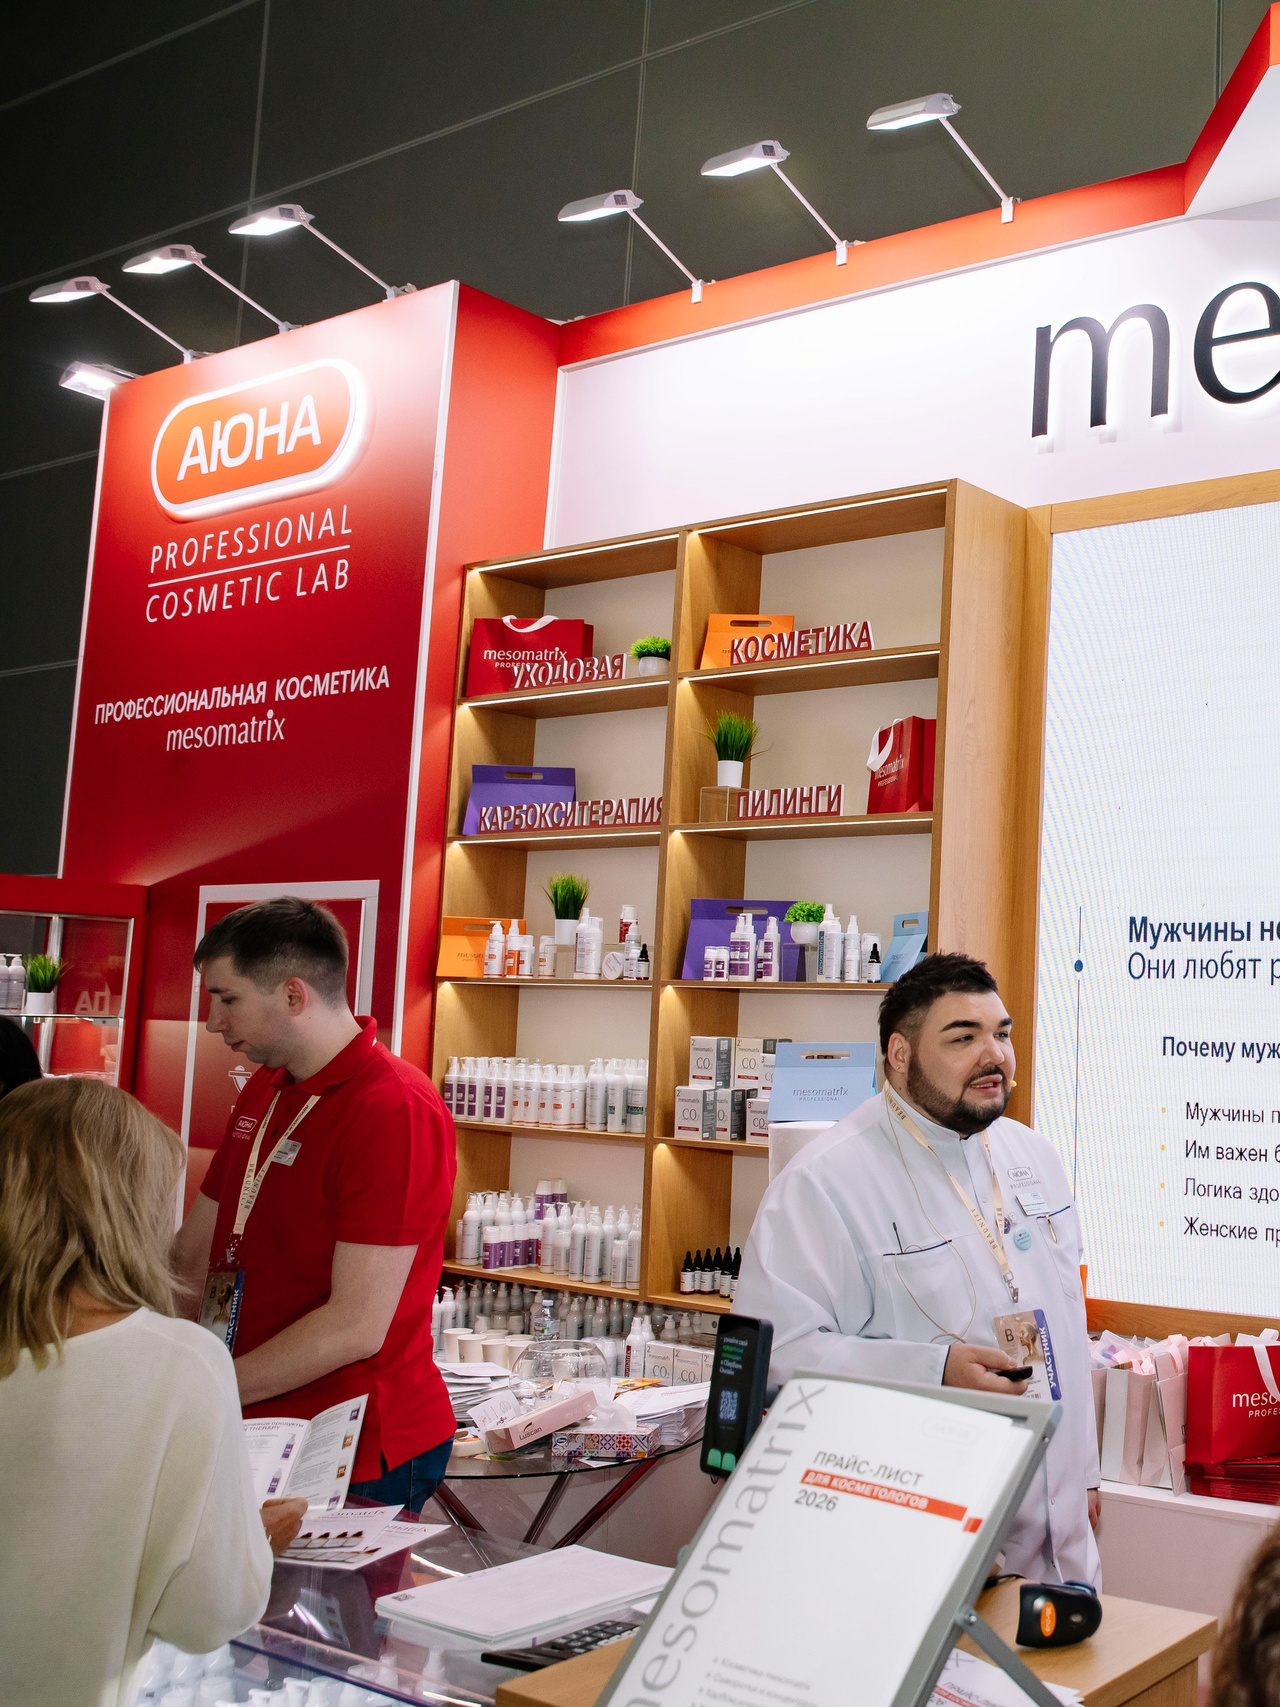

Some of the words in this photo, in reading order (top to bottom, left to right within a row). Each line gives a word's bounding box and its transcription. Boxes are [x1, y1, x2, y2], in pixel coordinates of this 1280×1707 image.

[176, 394, 322, 481] АЮНА
[150, 504, 352, 573] PROFESSIONAL
[146, 572, 281, 623] COSMETIC
[297, 559, 350, 597] LAB
[483, 647, 568, 662] mesomatrix
[731, 621, 875, 665] КОСМЕТИКА
[513, 653, 627, 689] УХОДОВАЯ
[95, 681, 267, 724] ПРОФЕССИОНАЛЬНАЯ
[275, 665, 390, 701] КОСМЕТИКА
[166, 709, 286, 751] mesomatrix
[479, 796, 663, 833] КАРБОКСИТЕРАПИЯ
[737, 784, 844, 820] ПИЛИНГИ
[1128, 916, 1251, 949] Мужчины
[1128, 952, 1175, 980] Они
[1183, 950, 1261, 980] любят
[1162, 1036, 1236, 1063] Почему
[792, 1086, 848, 1097] mesomatrix
[1185, 1101, 1264, 1127] Мужчины
[1185, 1139, 1210, 1159] Им
[1216, 1146, 1268, 1163] важен
[1184, 1178, 1242, 1199] Логика
[971, 1208, 998, 1250] BEAUNITY
[1183, 1216, 1258, 1240] Женские
[1039, 1327, 1057, 1388] УЧАСТНИК
[519, 1426, 542, 1441] Luscan
[813, 1451, 924, 1486] ПРАЙС-ЛИСТ
[795, 1489, 838, 1512] 2026
[804, 1472, 831, 1485] ДЛЯ
[831, 1477, 929, 1509] КОСМЕТОЛОГОВ
